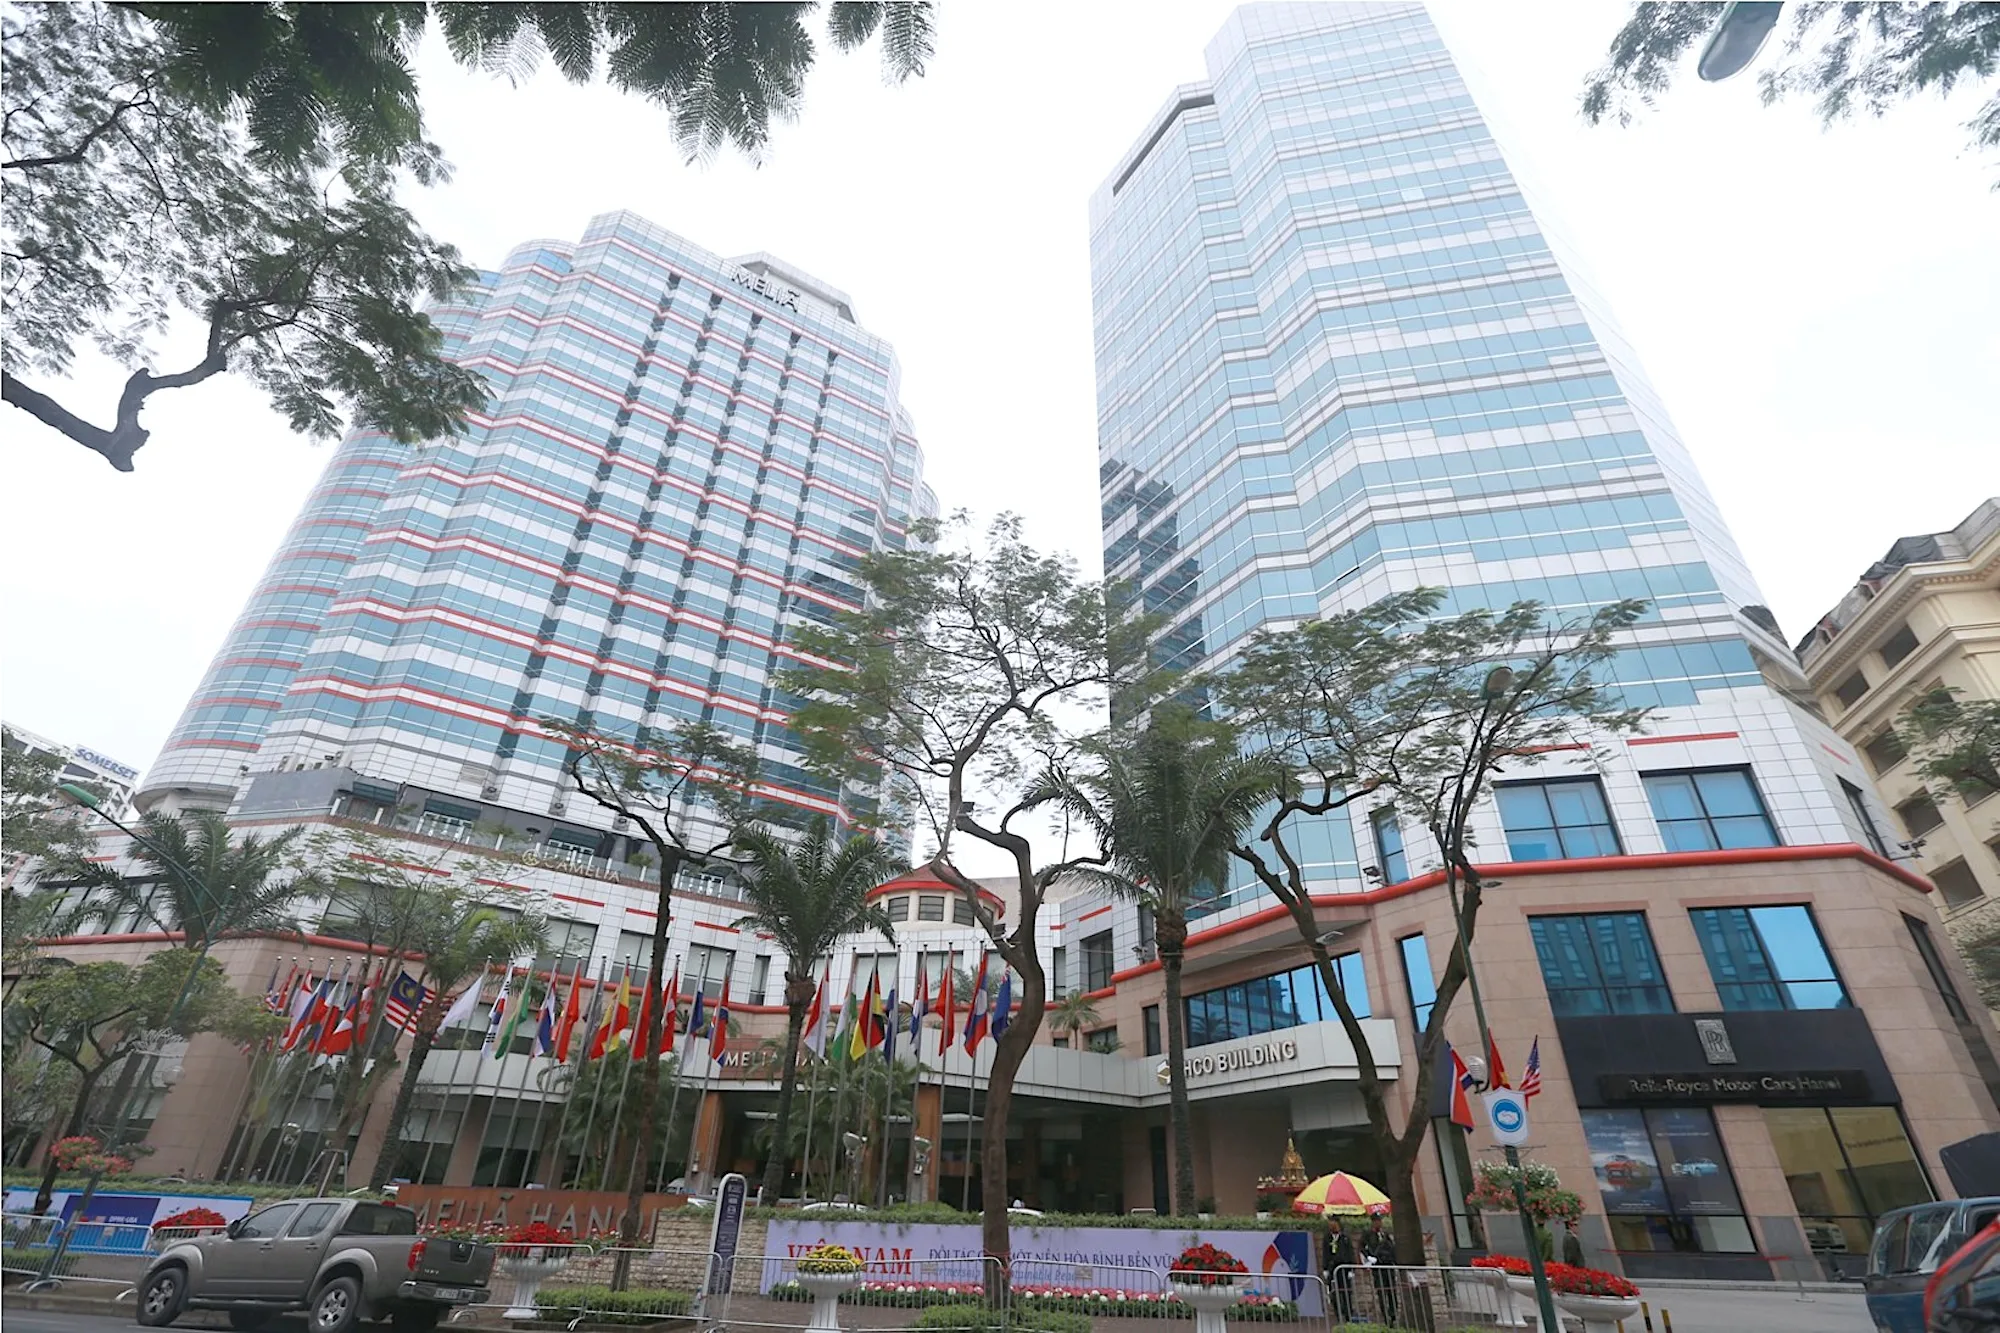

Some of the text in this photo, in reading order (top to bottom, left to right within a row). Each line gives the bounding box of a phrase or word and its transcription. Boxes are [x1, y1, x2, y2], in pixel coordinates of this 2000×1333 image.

[75, 748, 138, 780] SOMERSET
[1217, 1040, 1297, 1072] BUILDING
[1712, 1078, 1758, 1092] Motor
[1761, 1077, 1797, 1091] Cars
